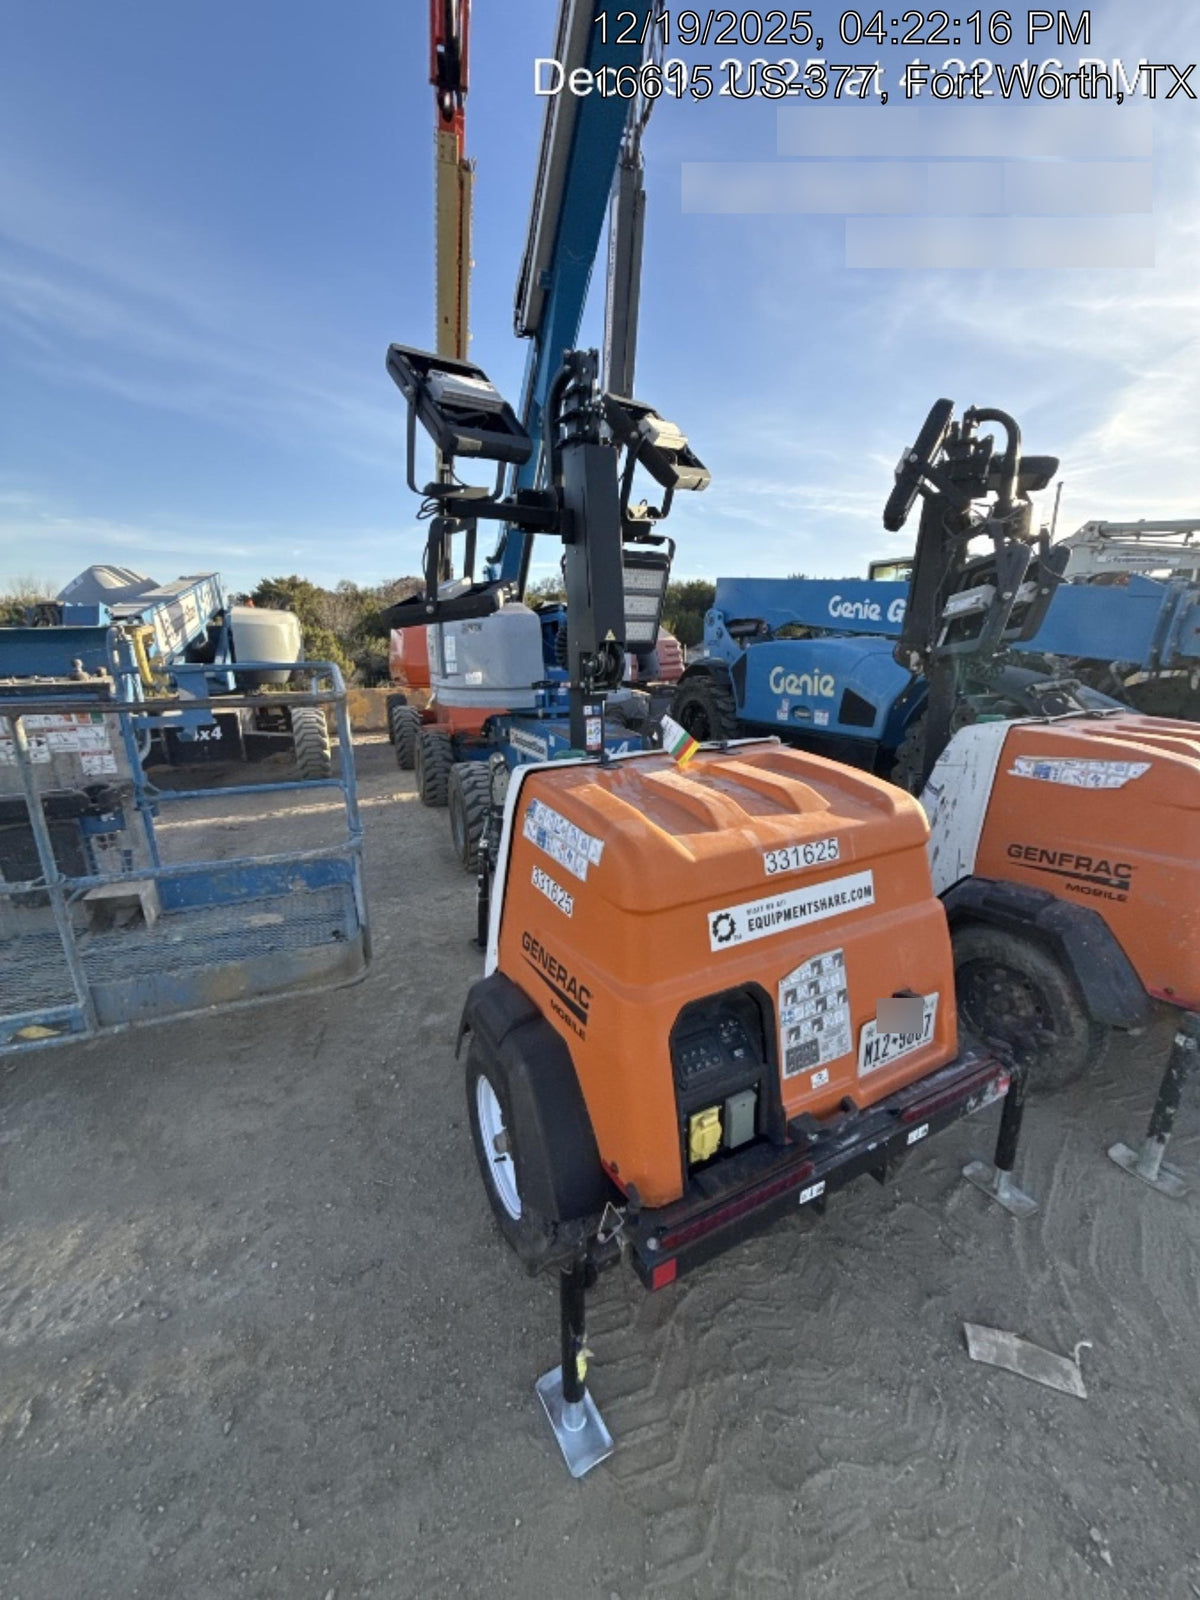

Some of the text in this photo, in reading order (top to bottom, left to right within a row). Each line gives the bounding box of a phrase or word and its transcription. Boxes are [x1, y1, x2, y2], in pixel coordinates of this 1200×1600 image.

[828, 594, 882, 621] Genie
[769, 666, 835, 698] Genie
[765, 838, 839, 874] 331625
[532, 866, 573, 915] 331625
[747, 884, 873, 932] EQUIPMENTSHARE.COM
[1065, 882, 1128, 903] MOBILE
[521, 931, 591, 1011] GENERAC
[550, 999, 586, 1043] MOBILE
